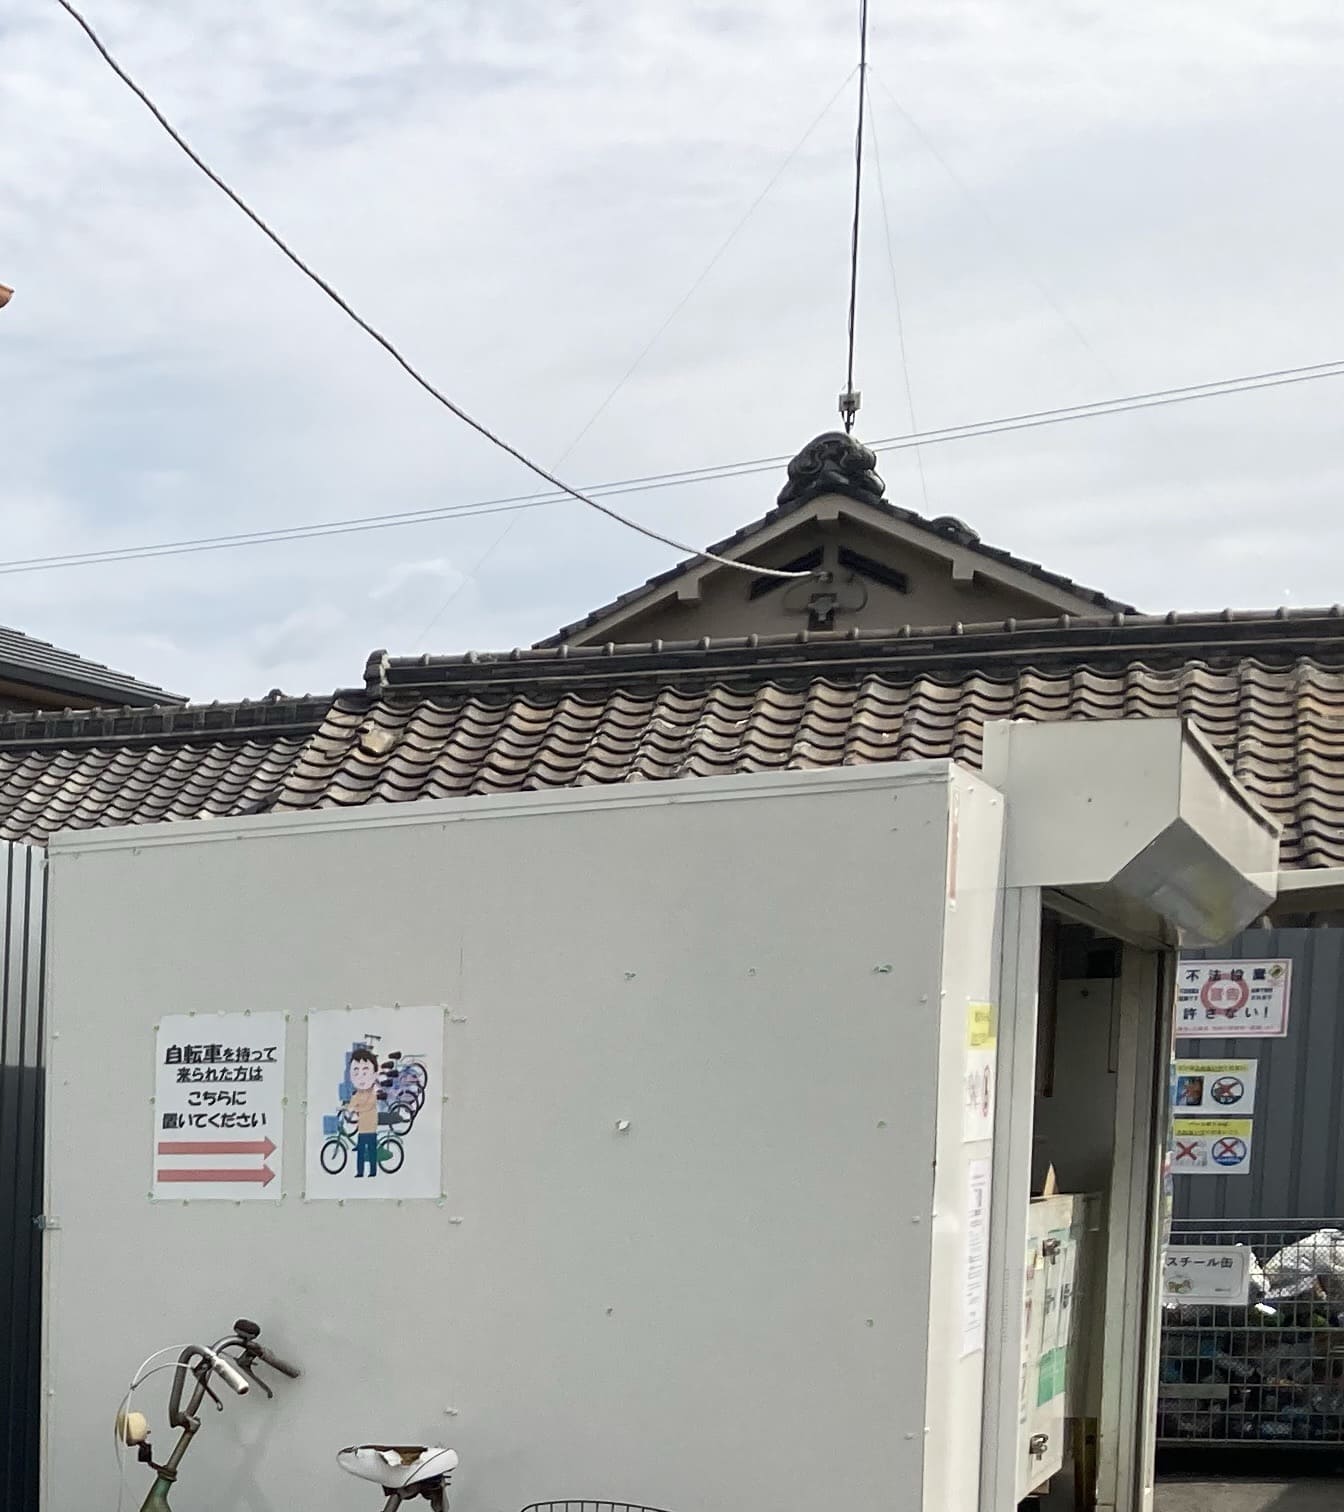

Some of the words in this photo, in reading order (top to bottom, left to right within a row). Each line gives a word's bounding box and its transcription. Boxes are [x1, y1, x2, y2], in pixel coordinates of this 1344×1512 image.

[164, 1044, 277, 1065] 自転車を持って
[176, 1066, 264, 1083] 来られた方は
[187, 1090, 248, 1106] こちらに
[162, 1112, 267, 1130] 置いてください
[1167, 1256, 1234, 1269] スチール缶
